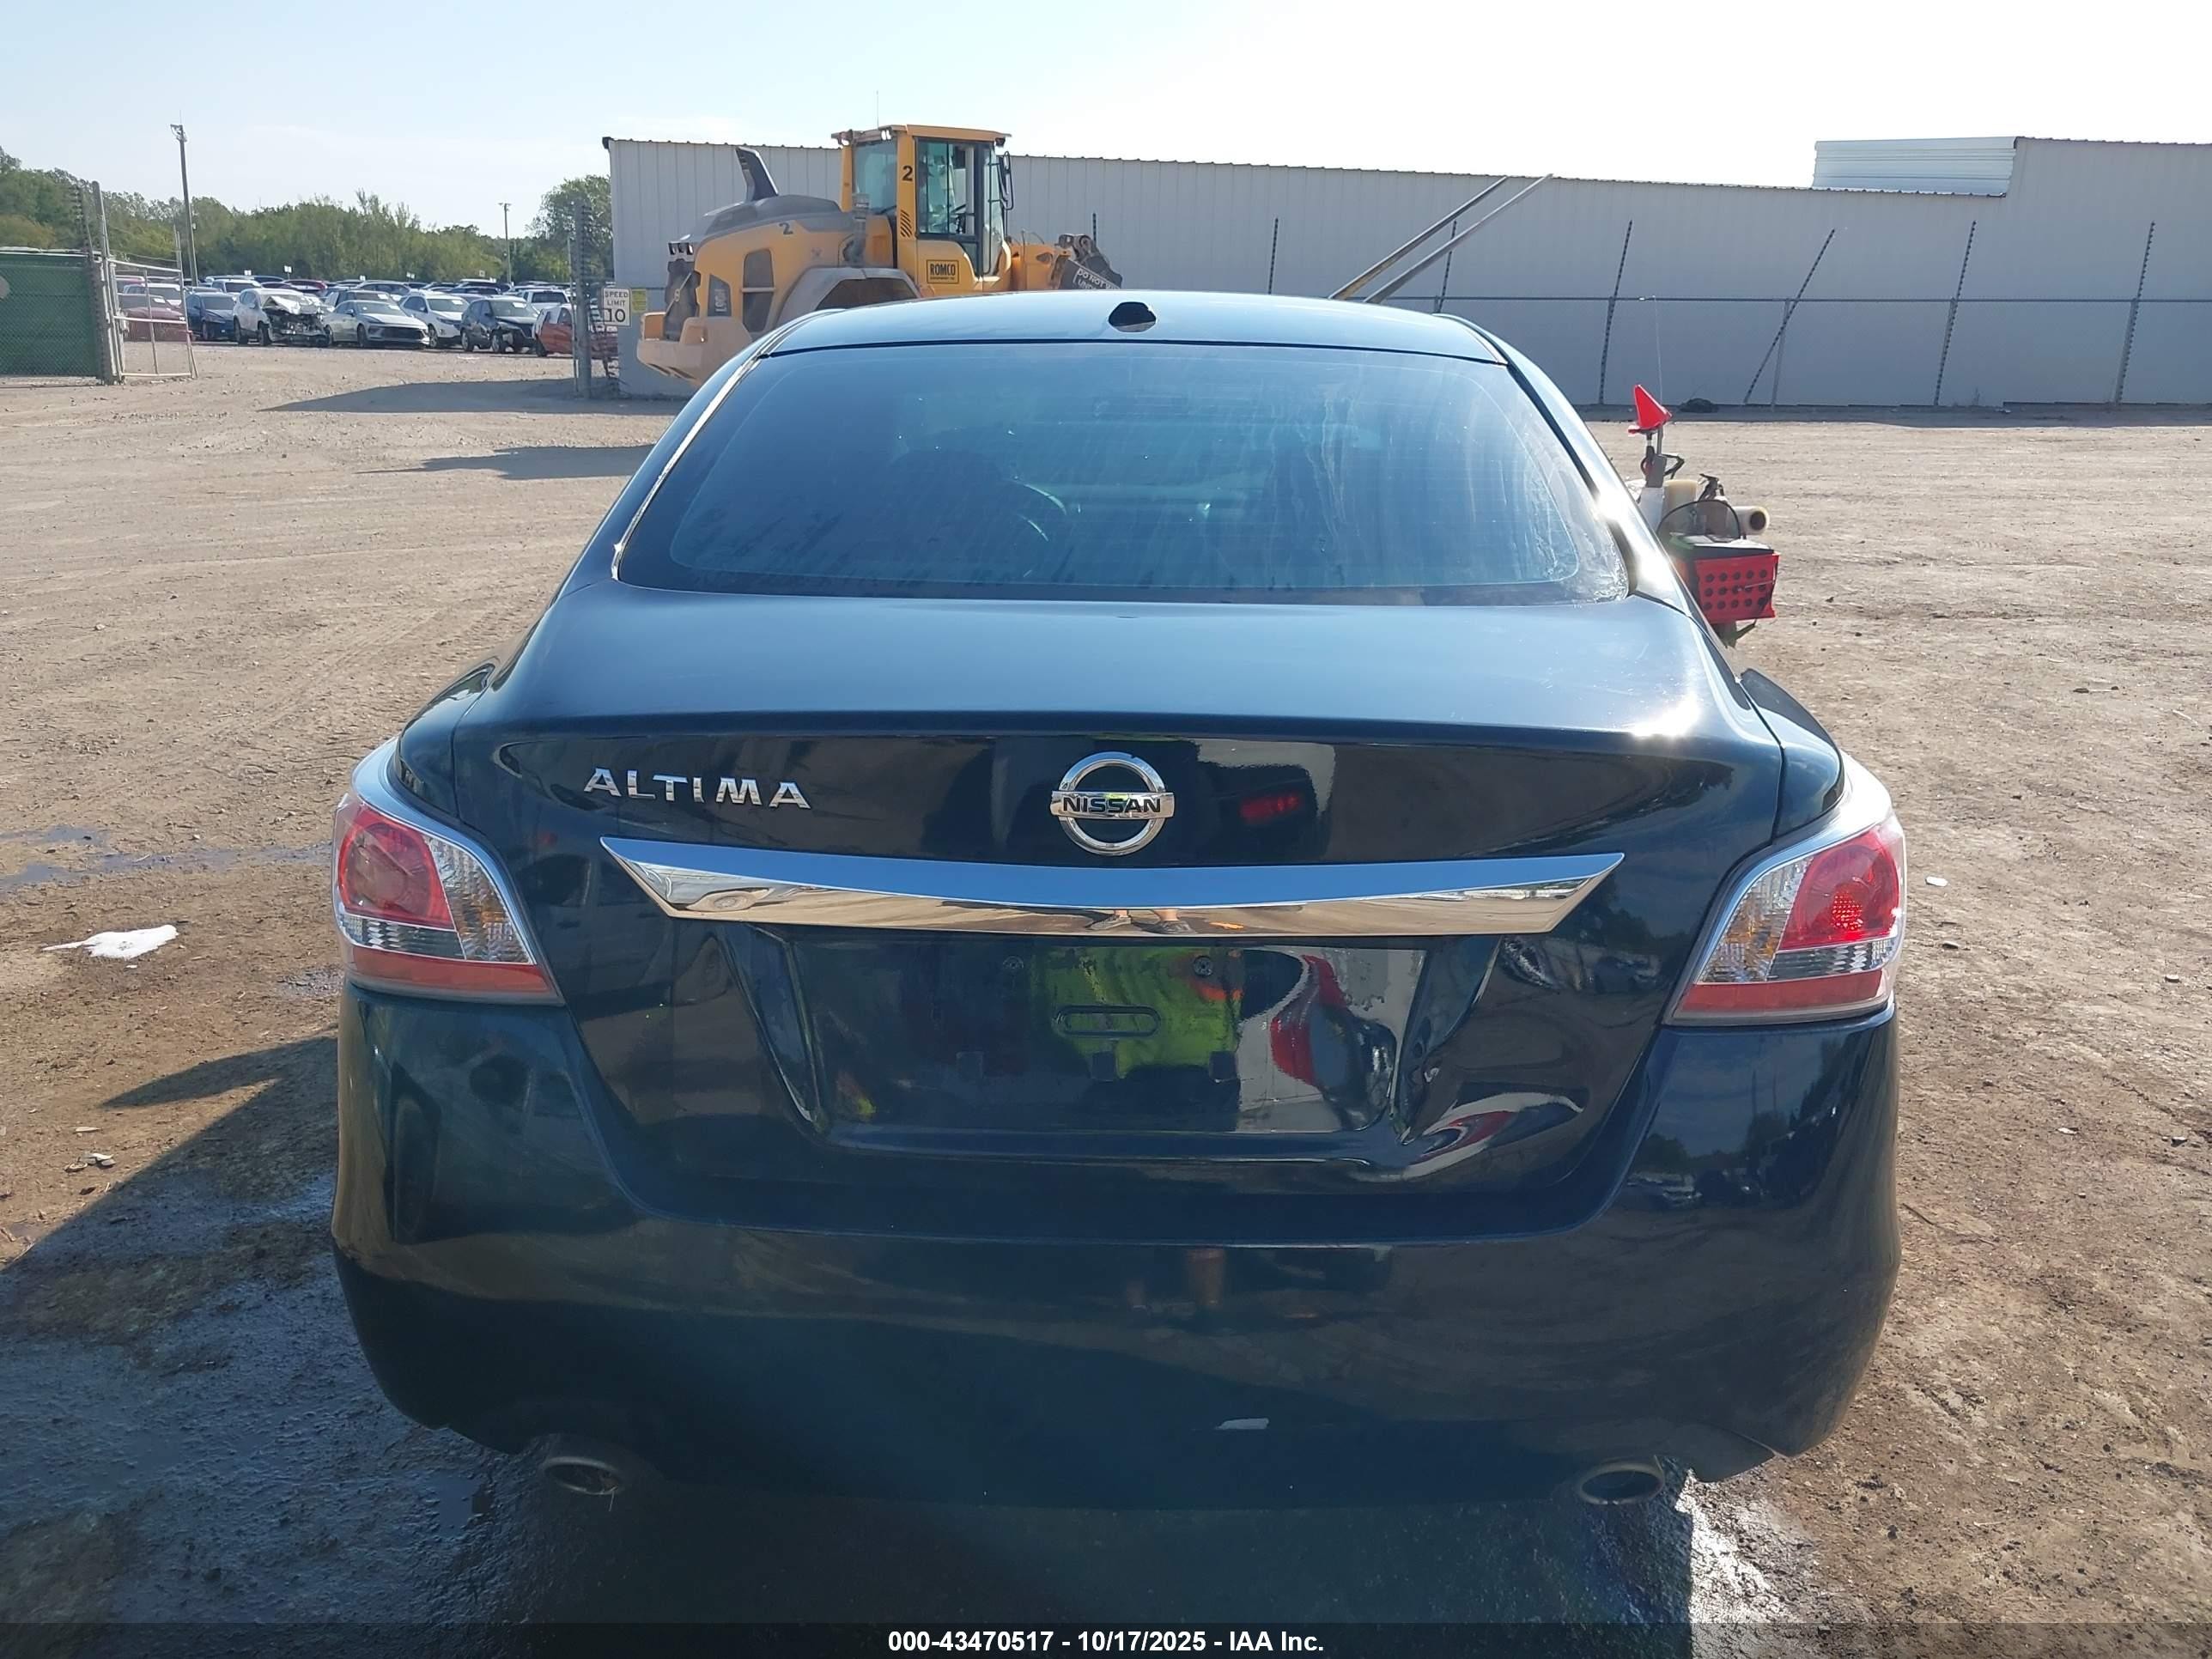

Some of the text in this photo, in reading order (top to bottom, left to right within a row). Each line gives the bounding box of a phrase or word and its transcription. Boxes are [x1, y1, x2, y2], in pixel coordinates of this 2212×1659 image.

[902, 165, 914, 182] 2
[779, 222, 794, 235] 2
[930, 263, 956, 276] ROMCO
[606, 308, 626, 323] 10
[584, 768, 811, 809] ALTIMA
[1063, 797, 1161, 813] NISSAN
